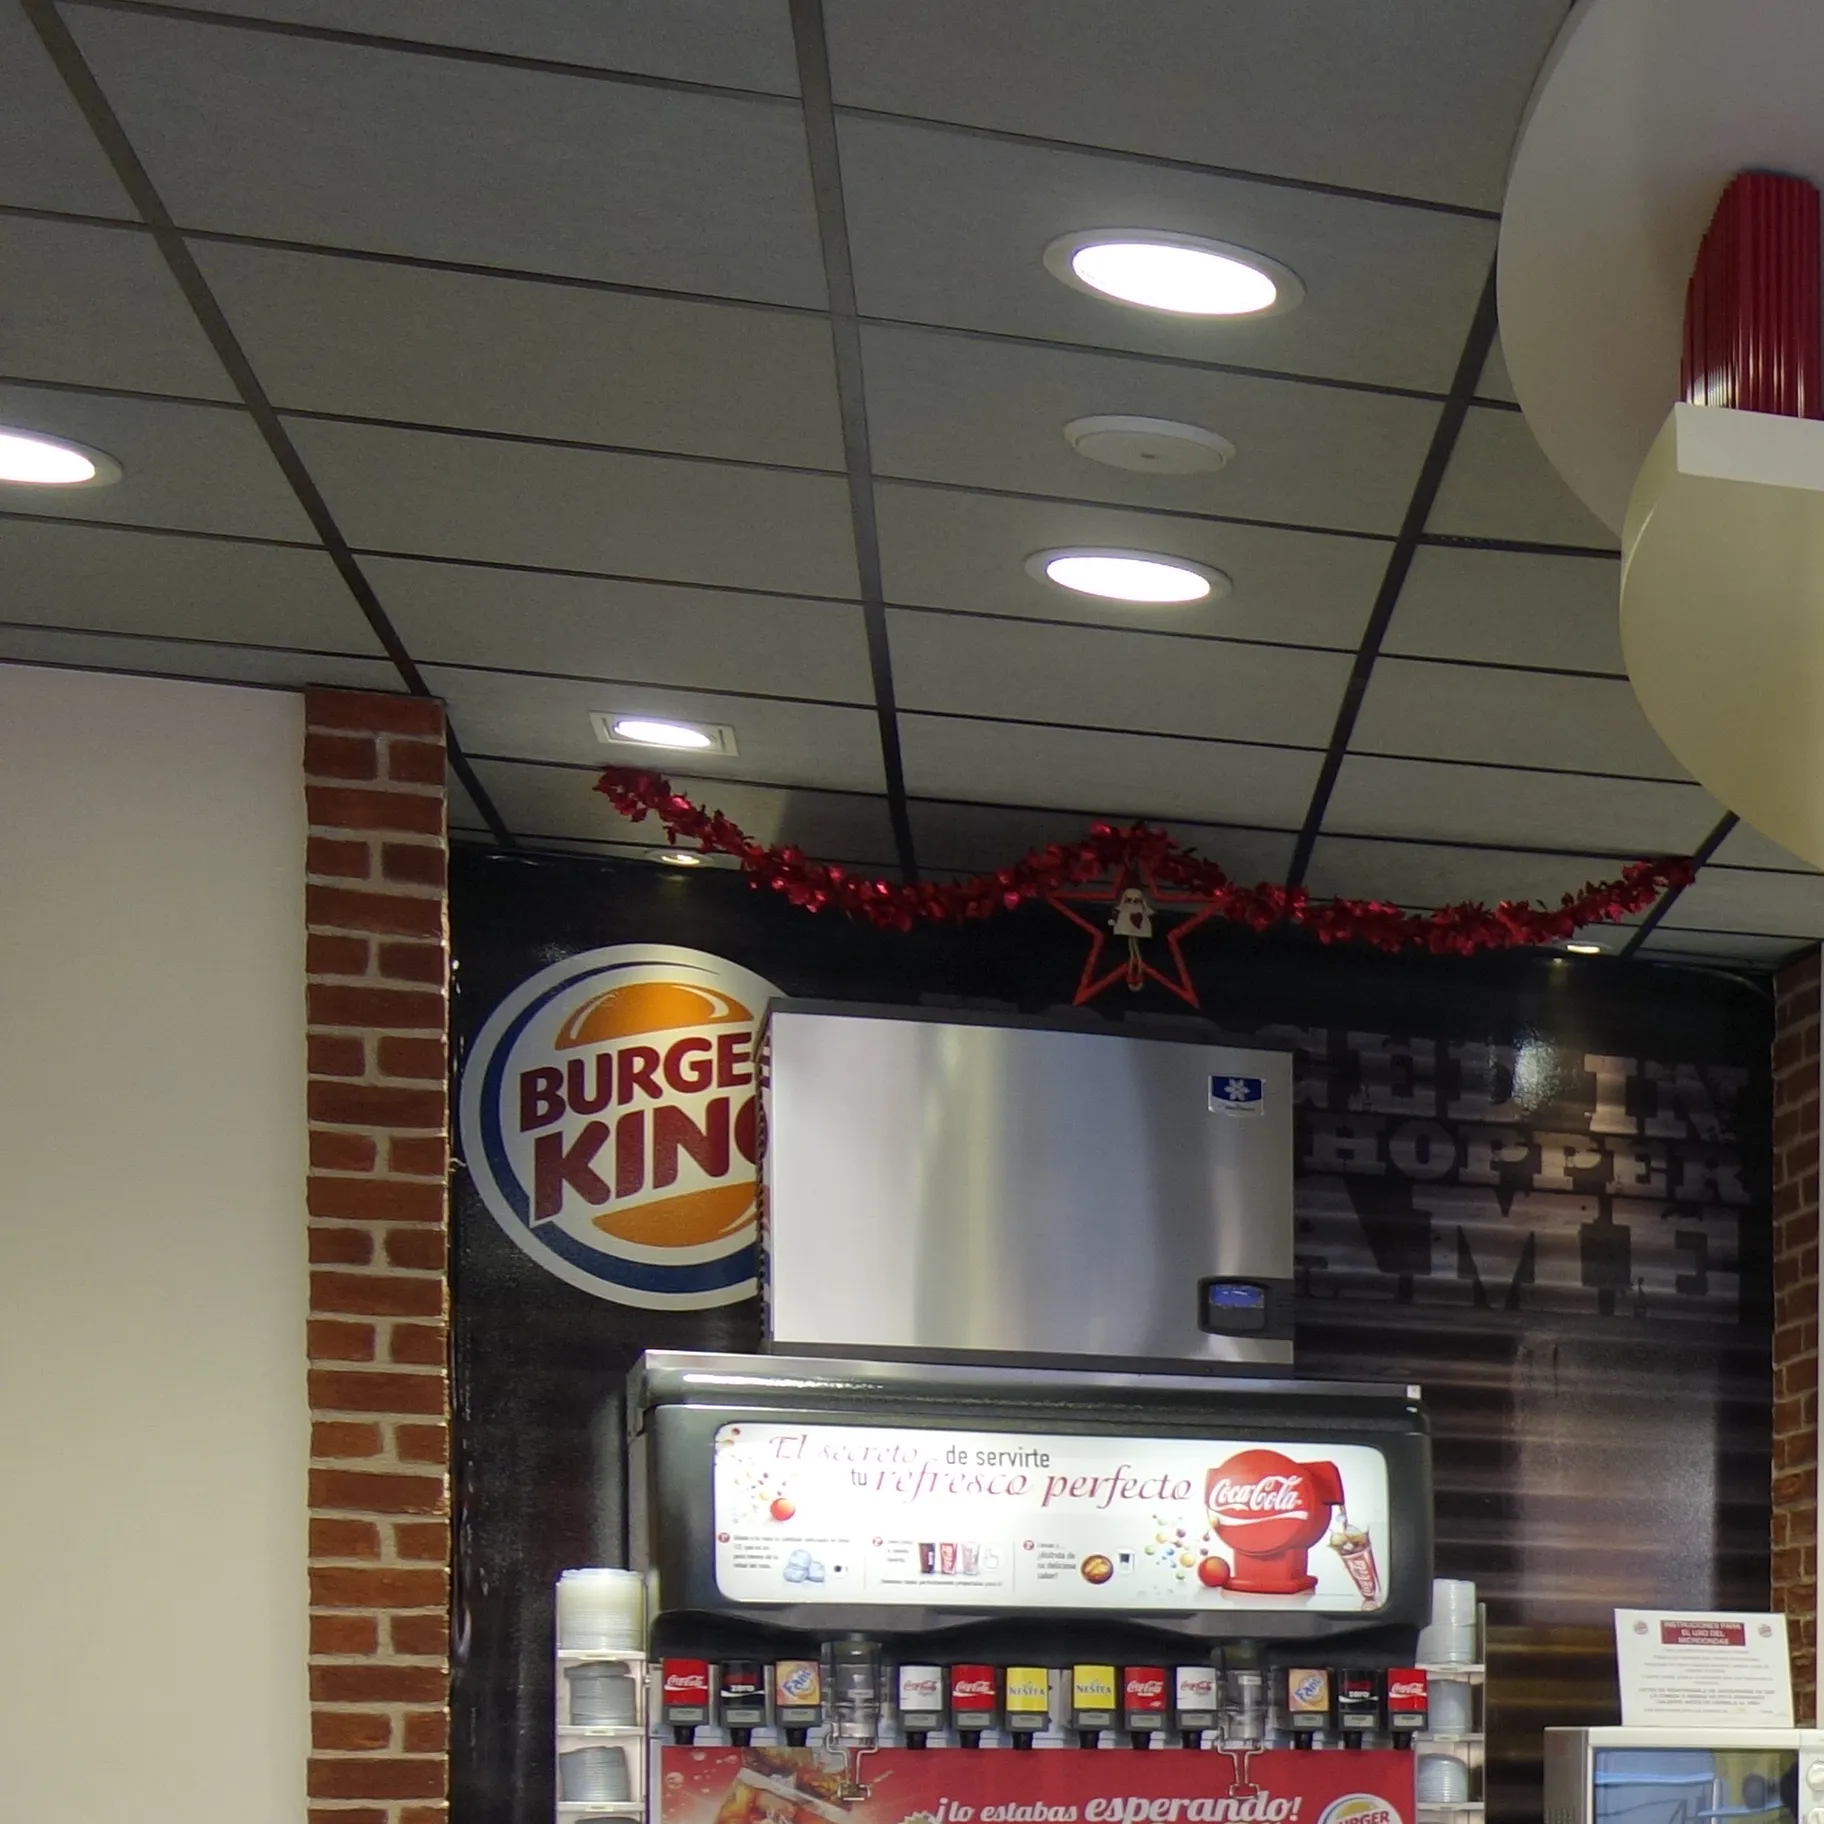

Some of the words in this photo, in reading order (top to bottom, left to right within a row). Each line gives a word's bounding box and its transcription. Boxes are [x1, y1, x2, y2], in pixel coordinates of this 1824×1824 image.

[520, 1031, 753, 1133] BURGE
[1302, 1118, 1752, 1205] HOPPER
[1294, 1174, 1741, 1323] AME
[769, 1434, 808, 1461] El
[945, 1446, 968, 1465] de
[976, 1446, 1051, 1468] servirte
[851, 1469, 867, 1487] tu
[875, 1457, 1029, 1502] refresco
[1039, 1465, 1193, 1510] perfecto
[1075, 1684, 1113, 1694] NESTEA
[979, 1801, 1079, 1823] estabas
